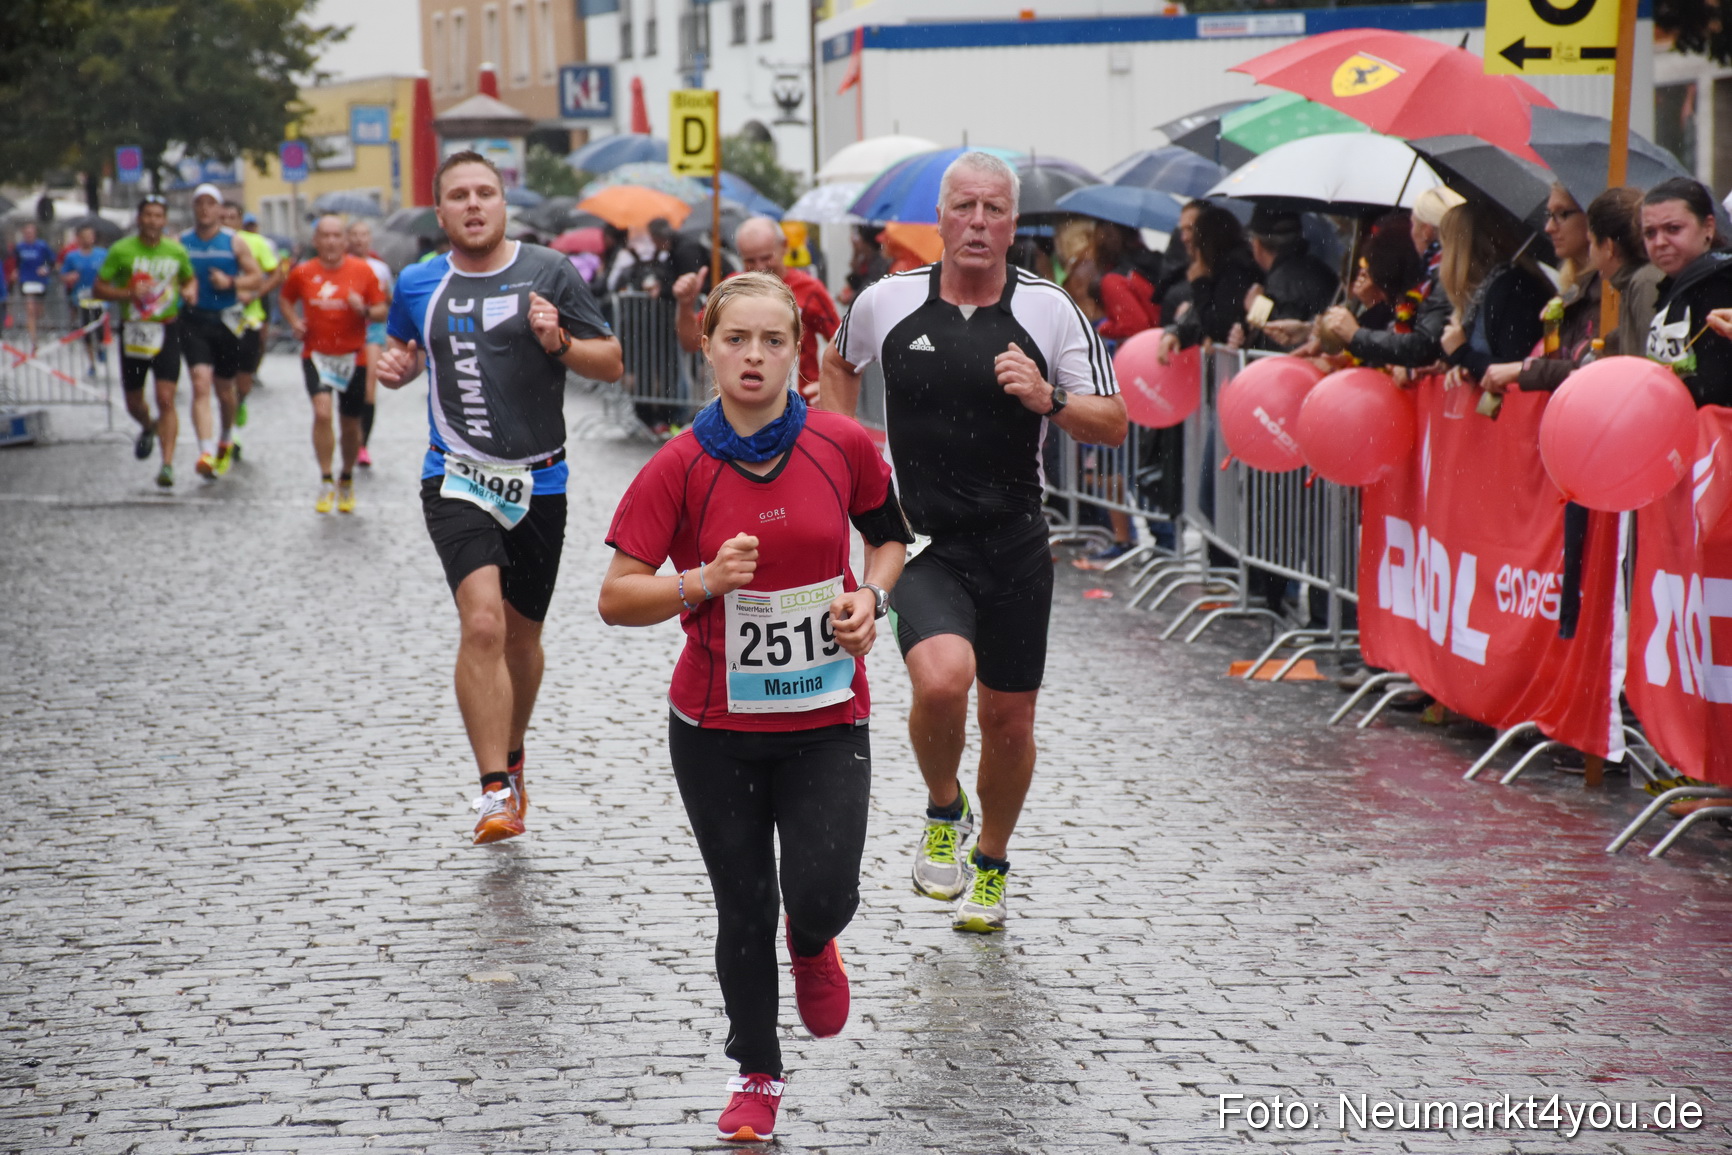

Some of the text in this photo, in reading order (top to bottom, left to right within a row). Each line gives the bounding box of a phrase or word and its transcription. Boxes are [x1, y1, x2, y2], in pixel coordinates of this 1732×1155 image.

[682, 116, 706, 155] D
[909, 344, 935, 352] adidas
[447, 298, 493, 439] HIMATEC
[759, 507, 786, 520] GORE
[780, 584, 835, 609] BOCK
[736, 604, 773, 613] NeuerMarkt
[740, 611, 840, 667] 2519
[731, 661, 738, 671] A
[764, 676, 823, 696] Marina
